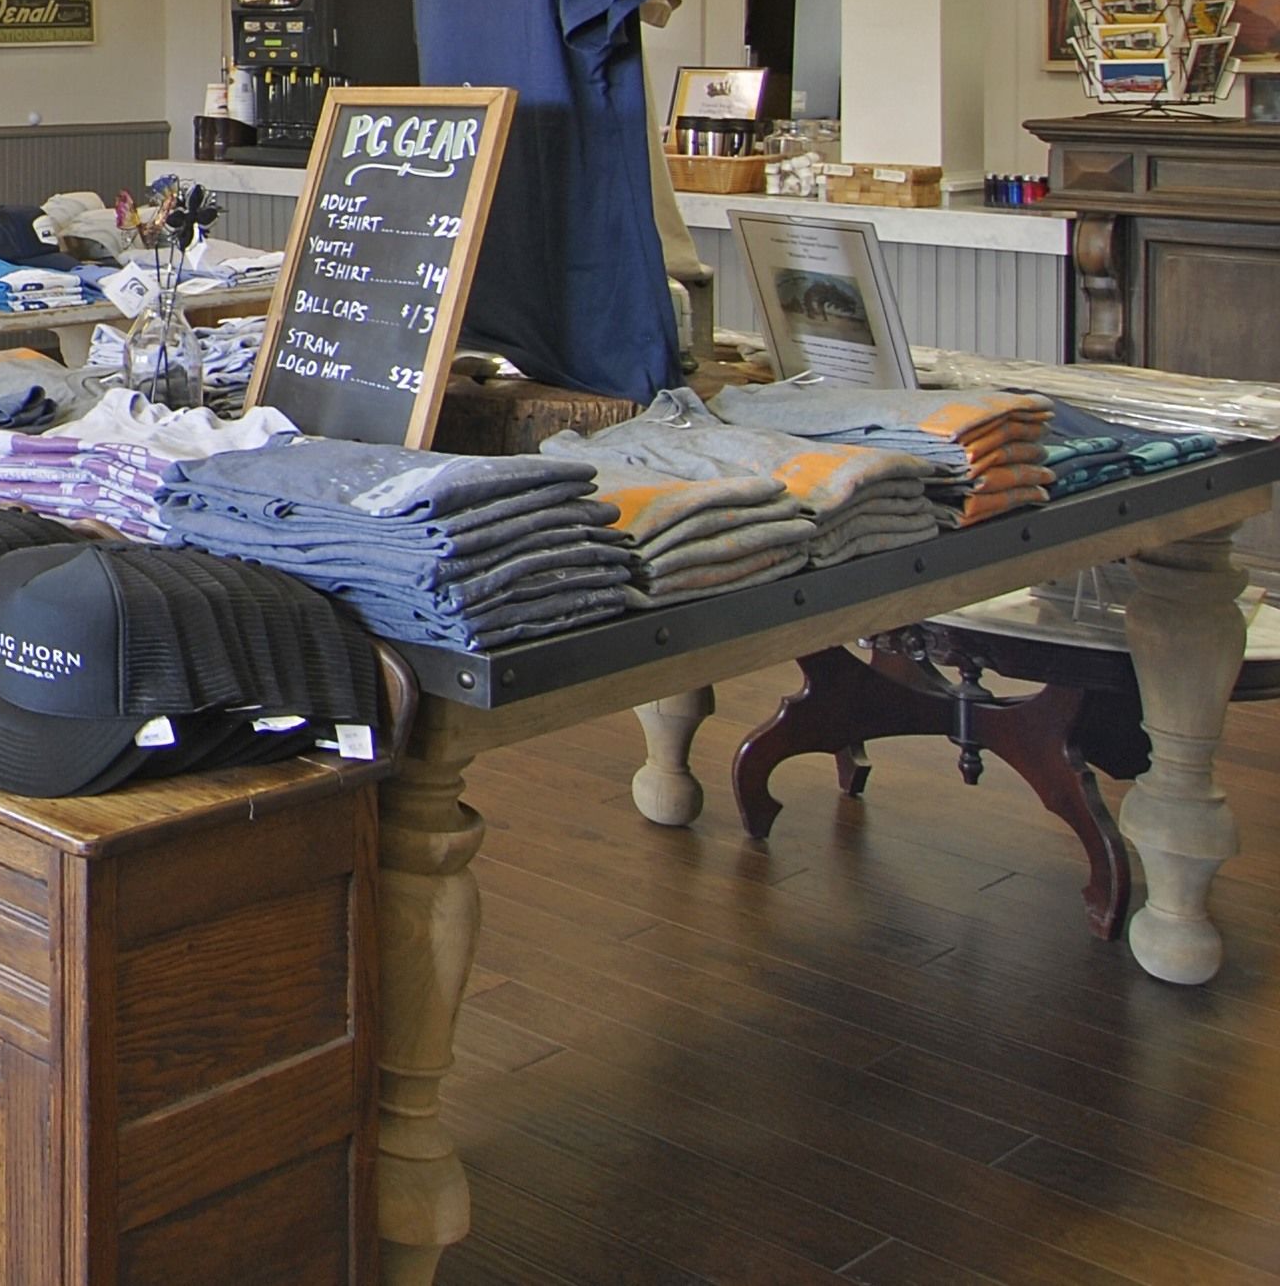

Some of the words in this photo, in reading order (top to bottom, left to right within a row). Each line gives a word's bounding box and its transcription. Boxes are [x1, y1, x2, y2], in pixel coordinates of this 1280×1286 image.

[393, 116, 478, 162] GEAR
[320, 194, 368, 212] ADULT
[327, 214, 383, 232] T-SHIRT
[427, 214, 461, 237] $22
[309, 235, 354, 257] YOUTH
[314, 258, 371, 282] T-SHIRT
[416, 263, 449, 294] $14
[295, 290, 329, 315] BALL
[332, 299, 368, 322] CAPS
[401, 304, 435, 334] $13
[286, 328, 340, 357] STRAW
[276, 350, 317, 376] LOGO
[321, 361, 352, 381] HAT
[389, 366, 425, 394] $23
[22, 641, 81, 668] HORN
[31, 659, 71, 675] GRILL
